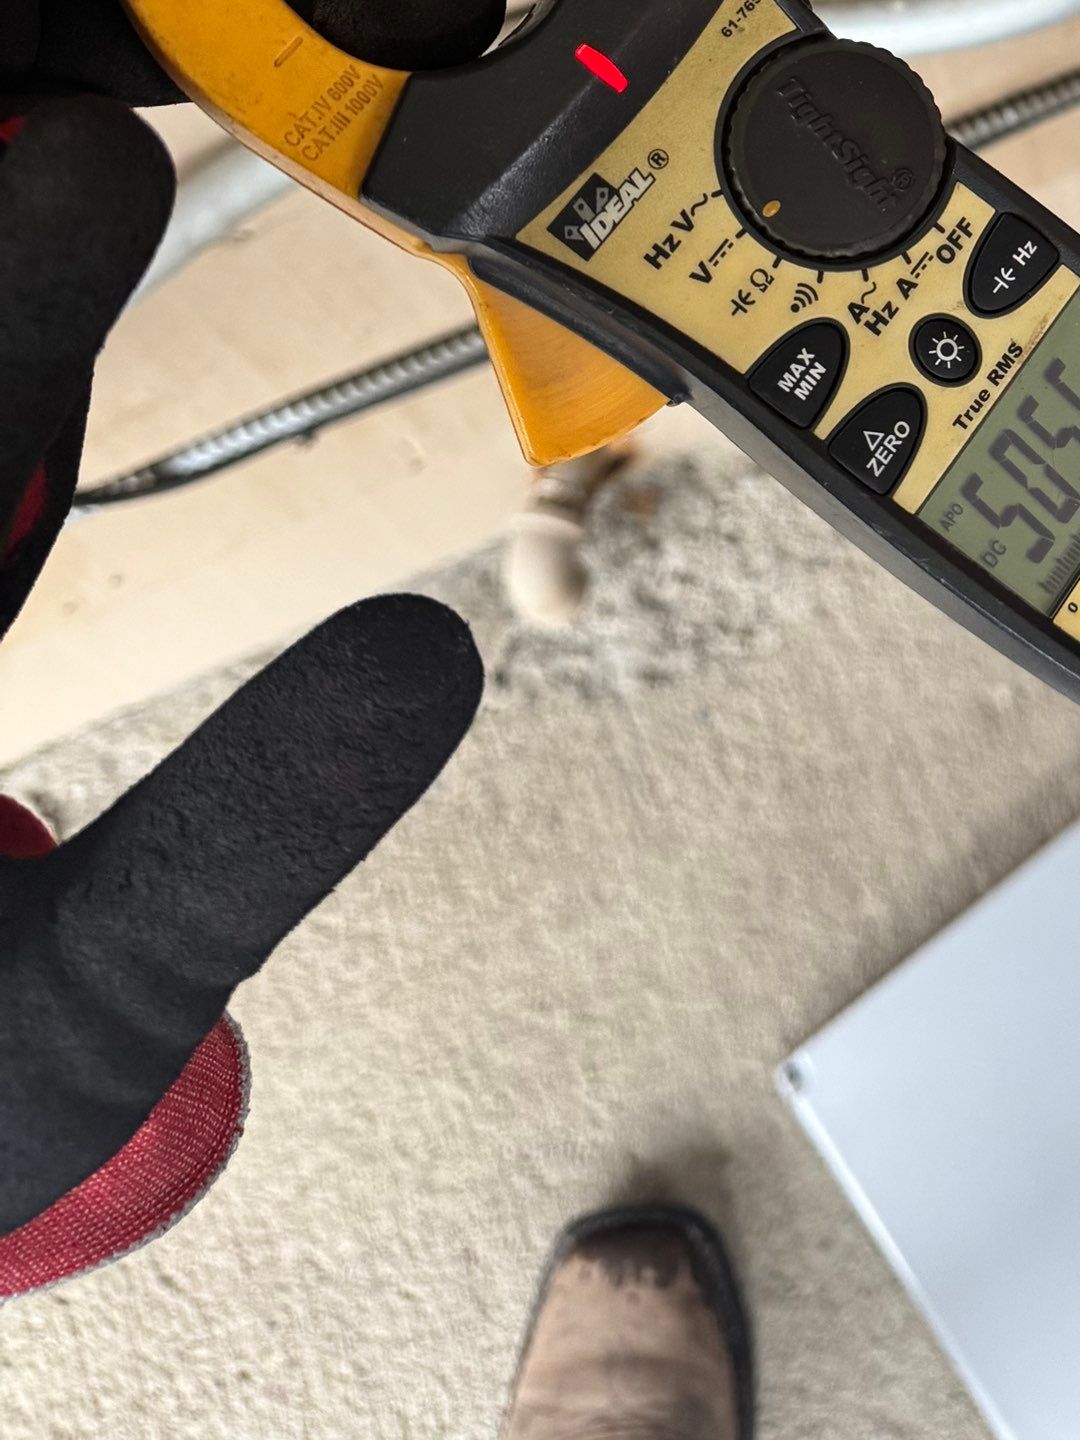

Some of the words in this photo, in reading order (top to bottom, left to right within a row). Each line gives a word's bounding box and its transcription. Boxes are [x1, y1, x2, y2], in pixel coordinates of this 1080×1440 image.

[327, 64, 360, 101] 600V
[345, 74, 384, 116] 1000V
[643, 234, 682, 270] Hz
[935, 217, 975, 265] OFF
[1012, 240, 1037, 266] Hz
[863, 300, 900, 337] Hz
[777, 347, 815, 393] MAX
[793, 361, 827, 401] MIN
[952, 387, 990, 431] True
[987, 342, 1023, 387] RMS
[866, 420, 910, 478] ZERO
[939, 503, 964, 533] APO
[980, 540, 1007, 568] DC
[1067, 601, 1079, 614] 0
